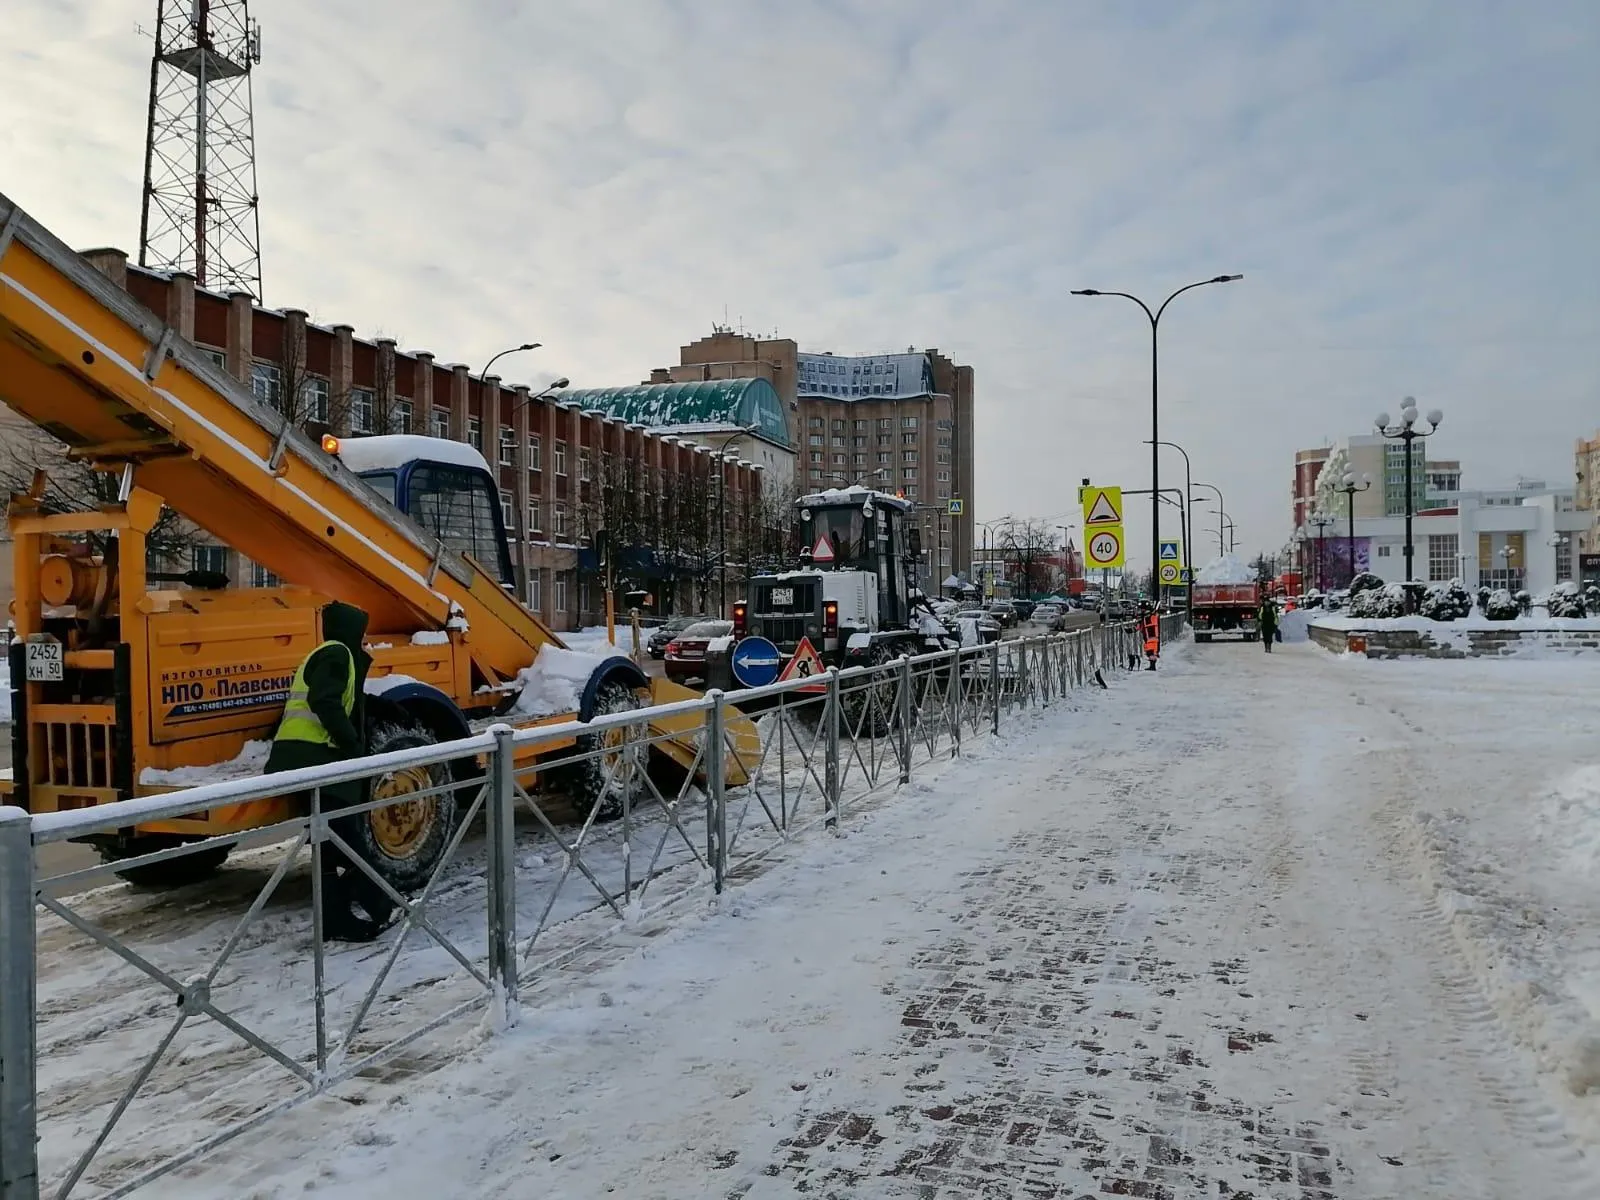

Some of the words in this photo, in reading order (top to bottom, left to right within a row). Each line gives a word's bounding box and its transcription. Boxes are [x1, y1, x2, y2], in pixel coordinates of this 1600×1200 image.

[1096, 542, 1112, 554] 40
[1164, 569, 1174, 577] 20
[30, 644, 58, 660] 2452
[49, 662, 60, 674] 50
[162, 682, 204, 704] НПО
